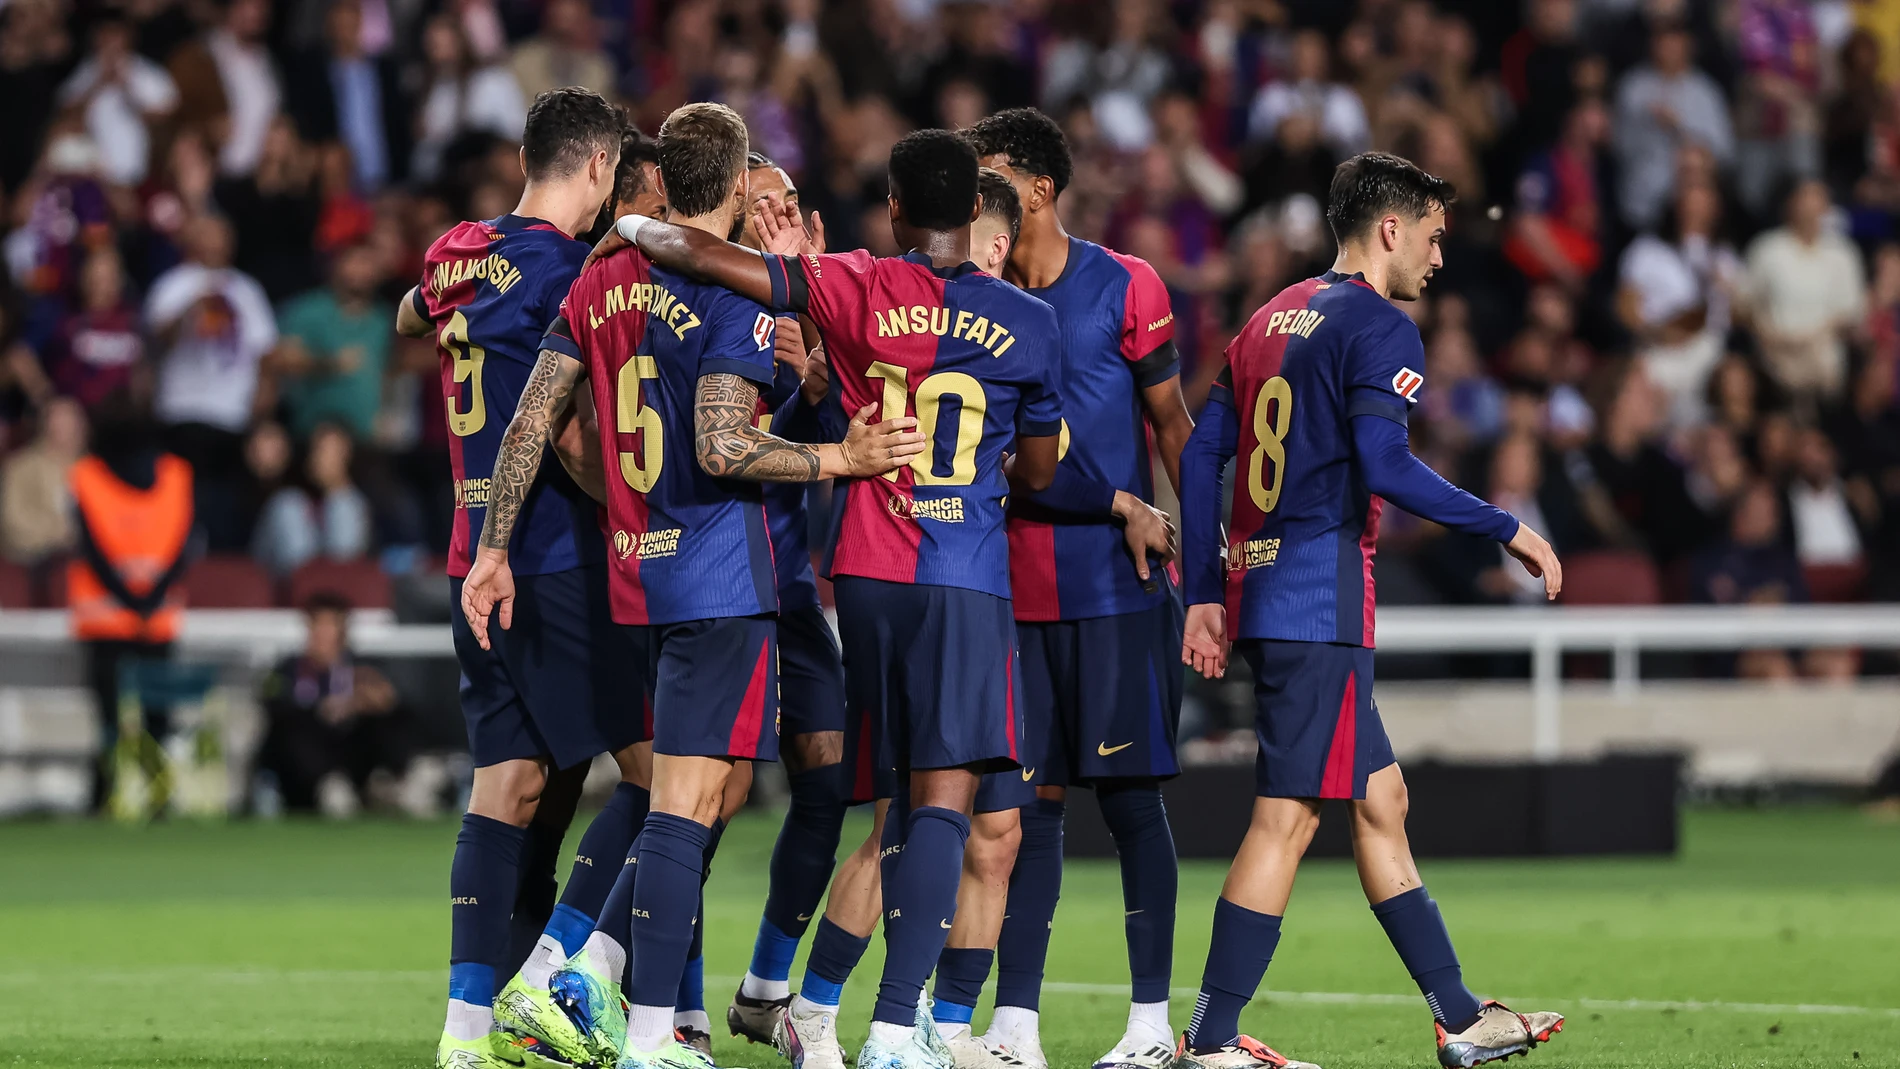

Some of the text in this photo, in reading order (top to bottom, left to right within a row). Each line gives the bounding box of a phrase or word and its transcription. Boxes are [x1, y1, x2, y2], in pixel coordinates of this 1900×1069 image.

[874, 305, 1016, 358] ANSU FATI
[1265, 309, 1325, 339] PEDRI
[440, 310, 487, 437] 9
[617, 355, 664, 493] 5
[865, 360, 987, 486] 10
[1248, 376, 1292, 513] 8
[463, 478, 491, 491] UNHC
[464, 490, 490, 503] ACNU
[636, 539, 678, 555] ACNUR
[640, 528, 682, 544] UNHCR
[1244, 538, 1281, 553] UNHCR
[1245, 549, 1278, 565] ACNUR
